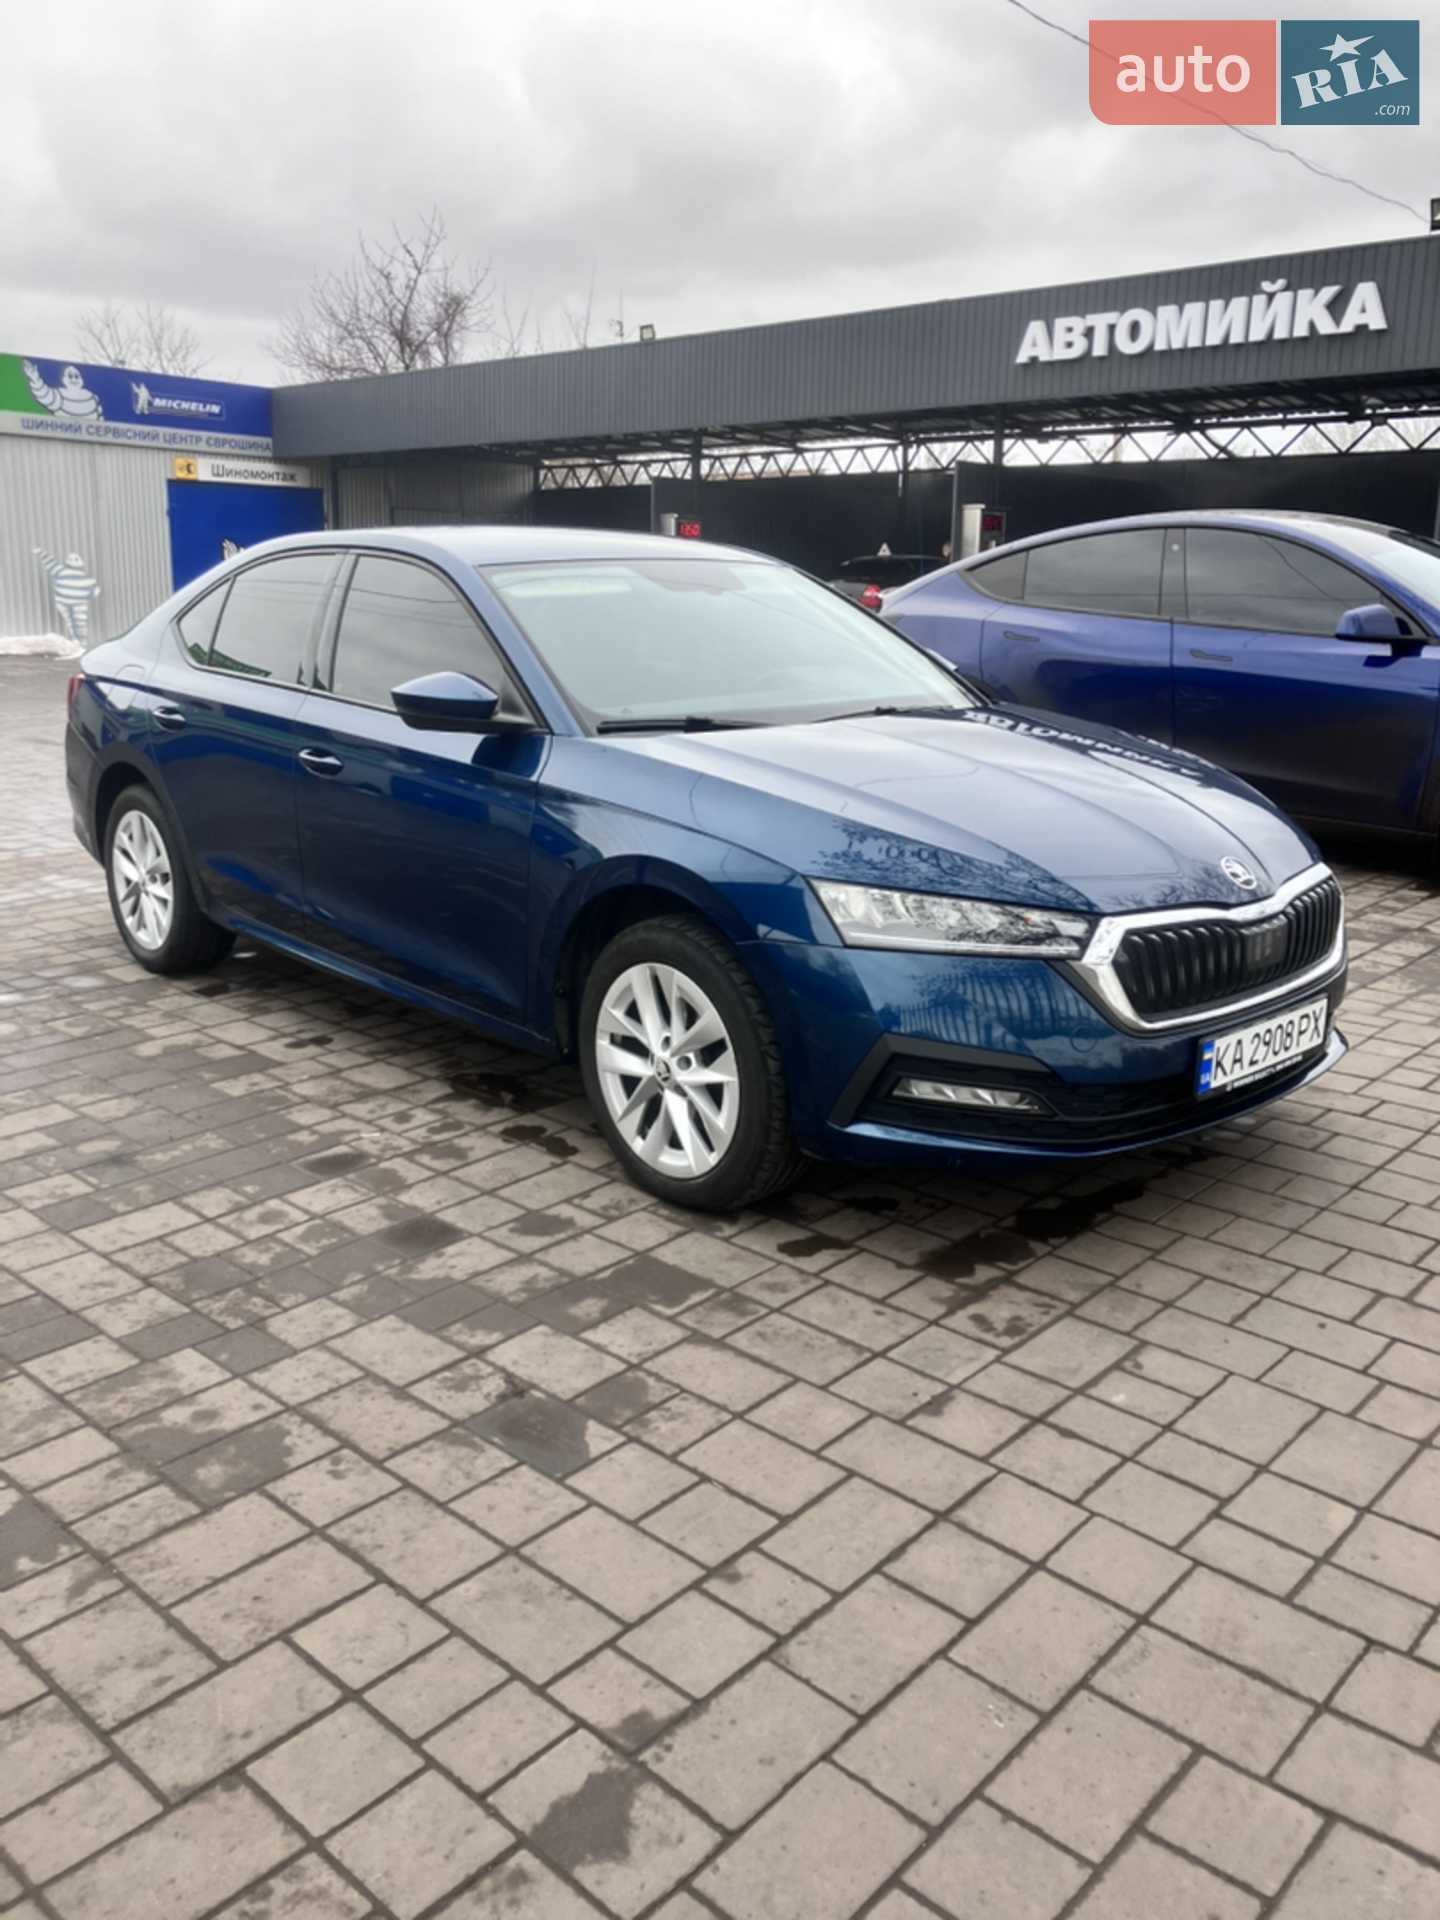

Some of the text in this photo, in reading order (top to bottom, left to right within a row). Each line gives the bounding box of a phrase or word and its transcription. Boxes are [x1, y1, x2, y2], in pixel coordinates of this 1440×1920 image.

[1014, 278, 1388, 364] АВТОМИЙКА
[153, 397, 221, 414] MICHELIN
[21, 417, 272, 452] ШИННИЙ СЕРВІСНИЙ ЦЕНТР ЄВРОШИНА
[211, 463, 298, 483] Шиномонтаж
[1213, 1039, 1244, 1081] KA
[1248, 1020, 1295, 1067] 2908
[1296, 1006, 1324, 1047] PX
